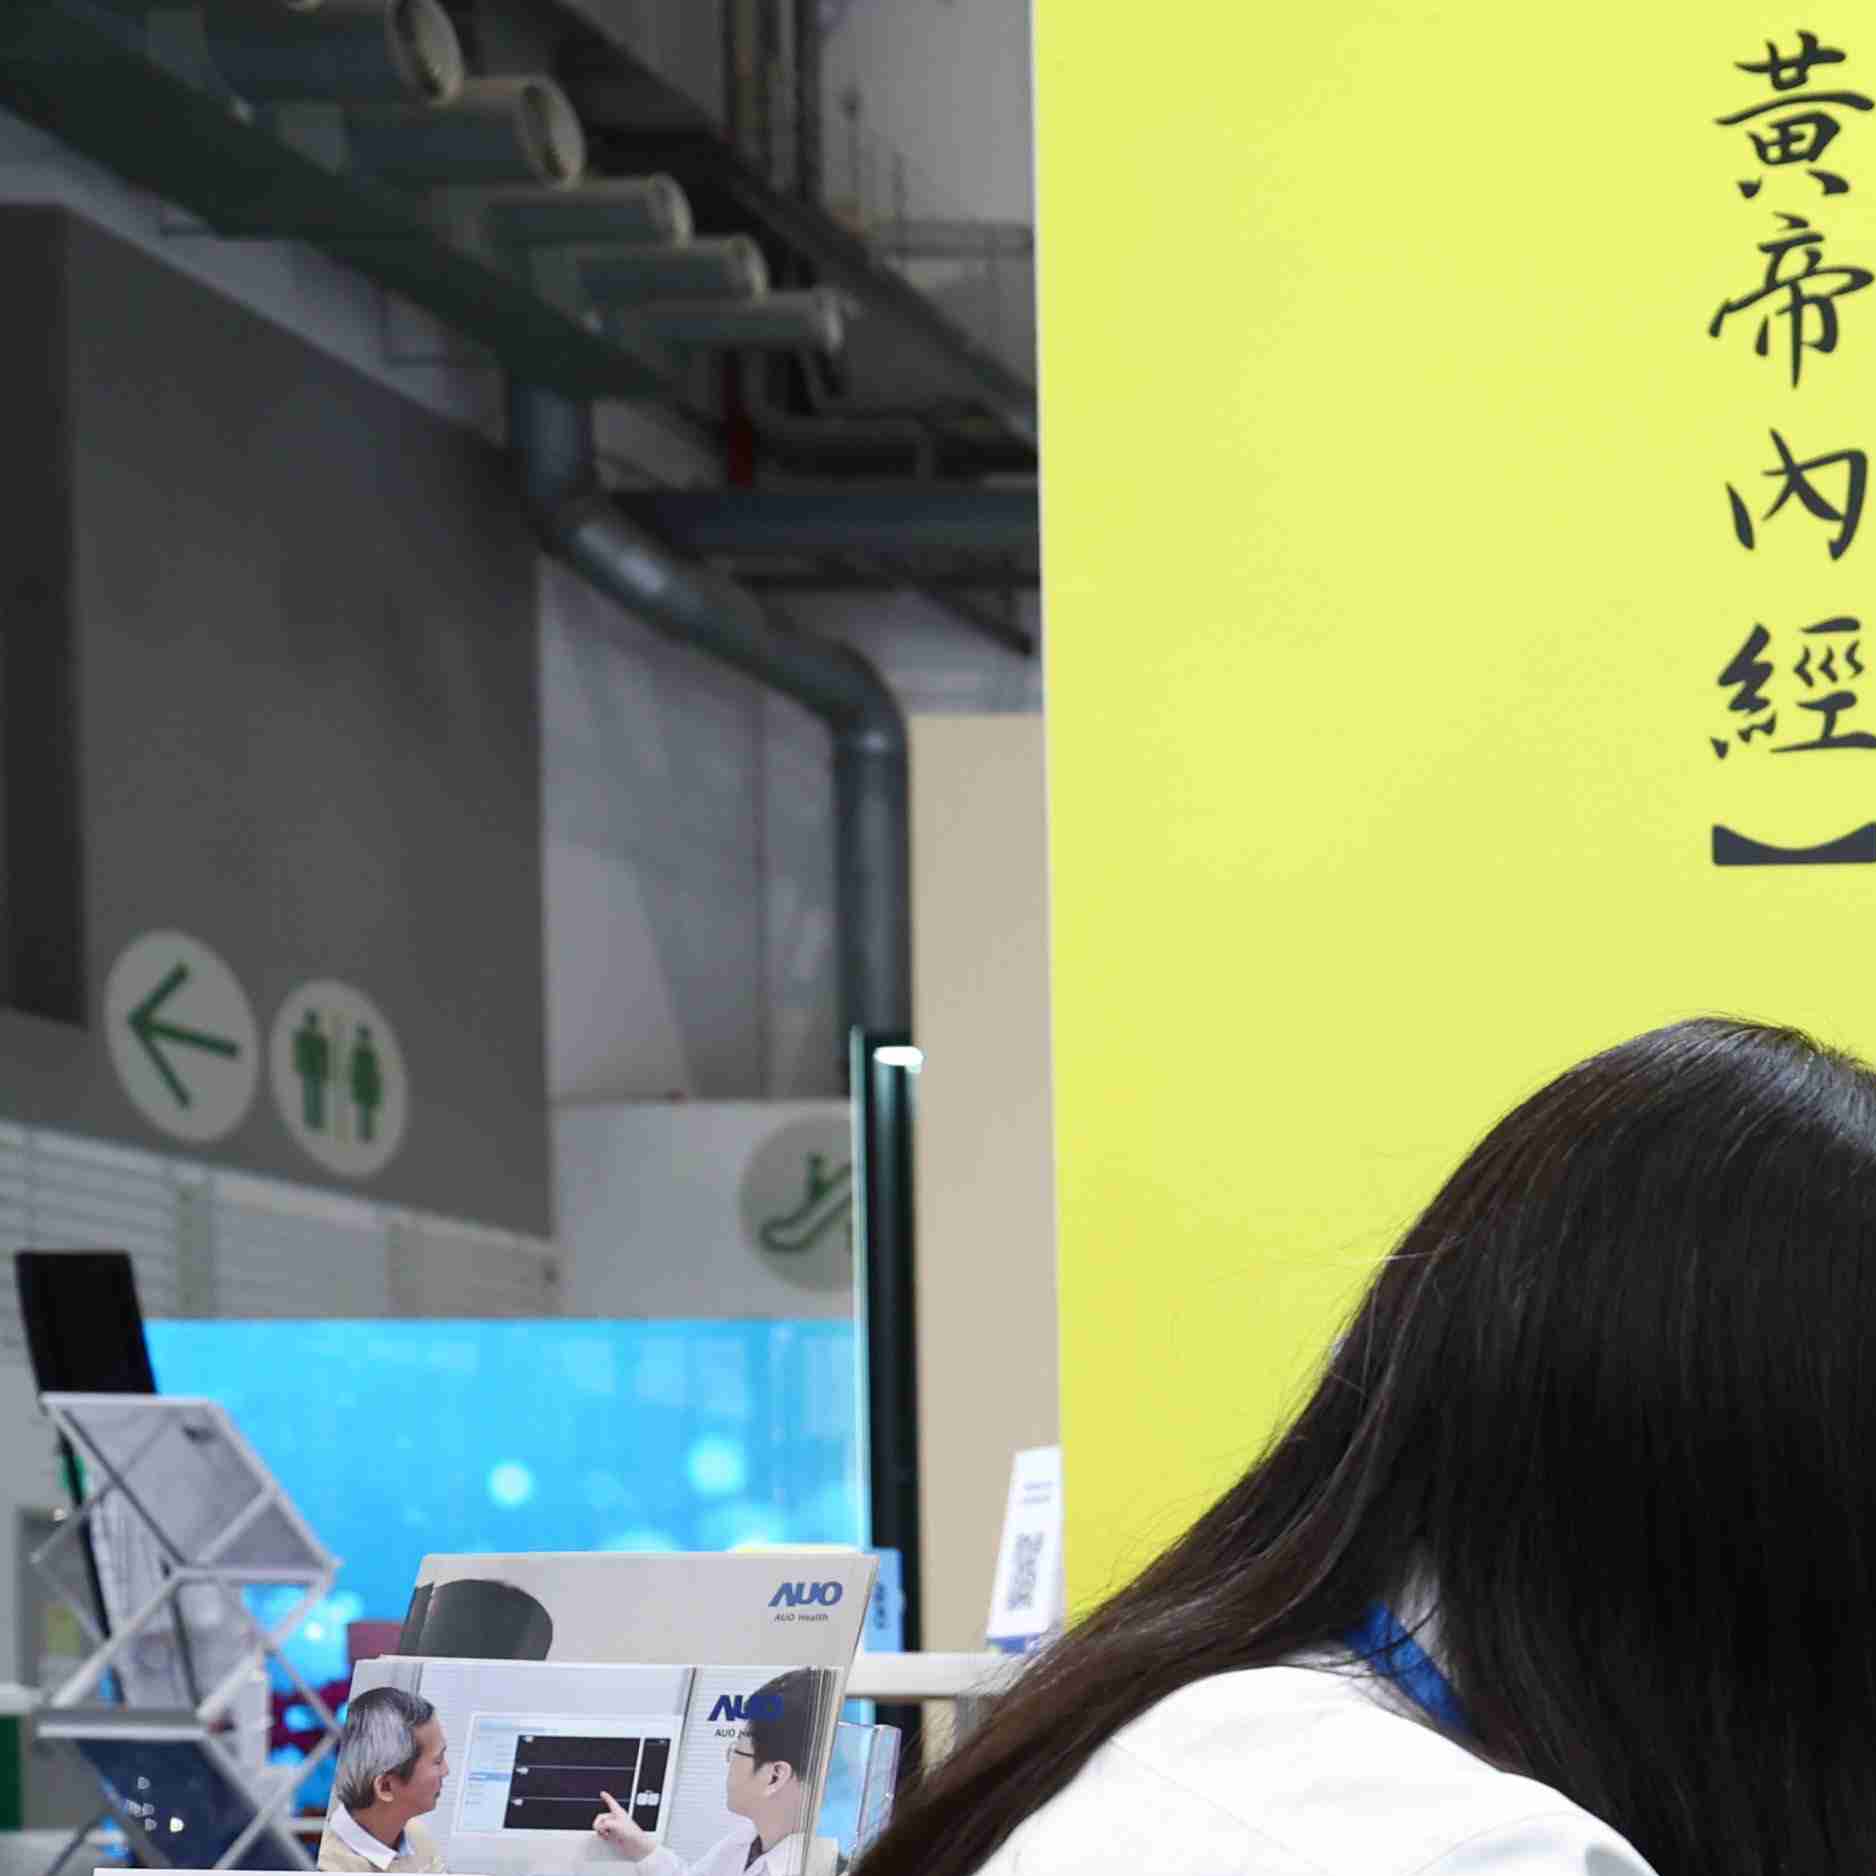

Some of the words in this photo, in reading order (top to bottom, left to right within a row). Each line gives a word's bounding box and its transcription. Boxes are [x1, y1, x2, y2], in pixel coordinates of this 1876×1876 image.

[768, 1581, 843, 1607] AUO
[774, 1614, 795, 1622] AUO
[799, 1614, 829, 1622] Health
